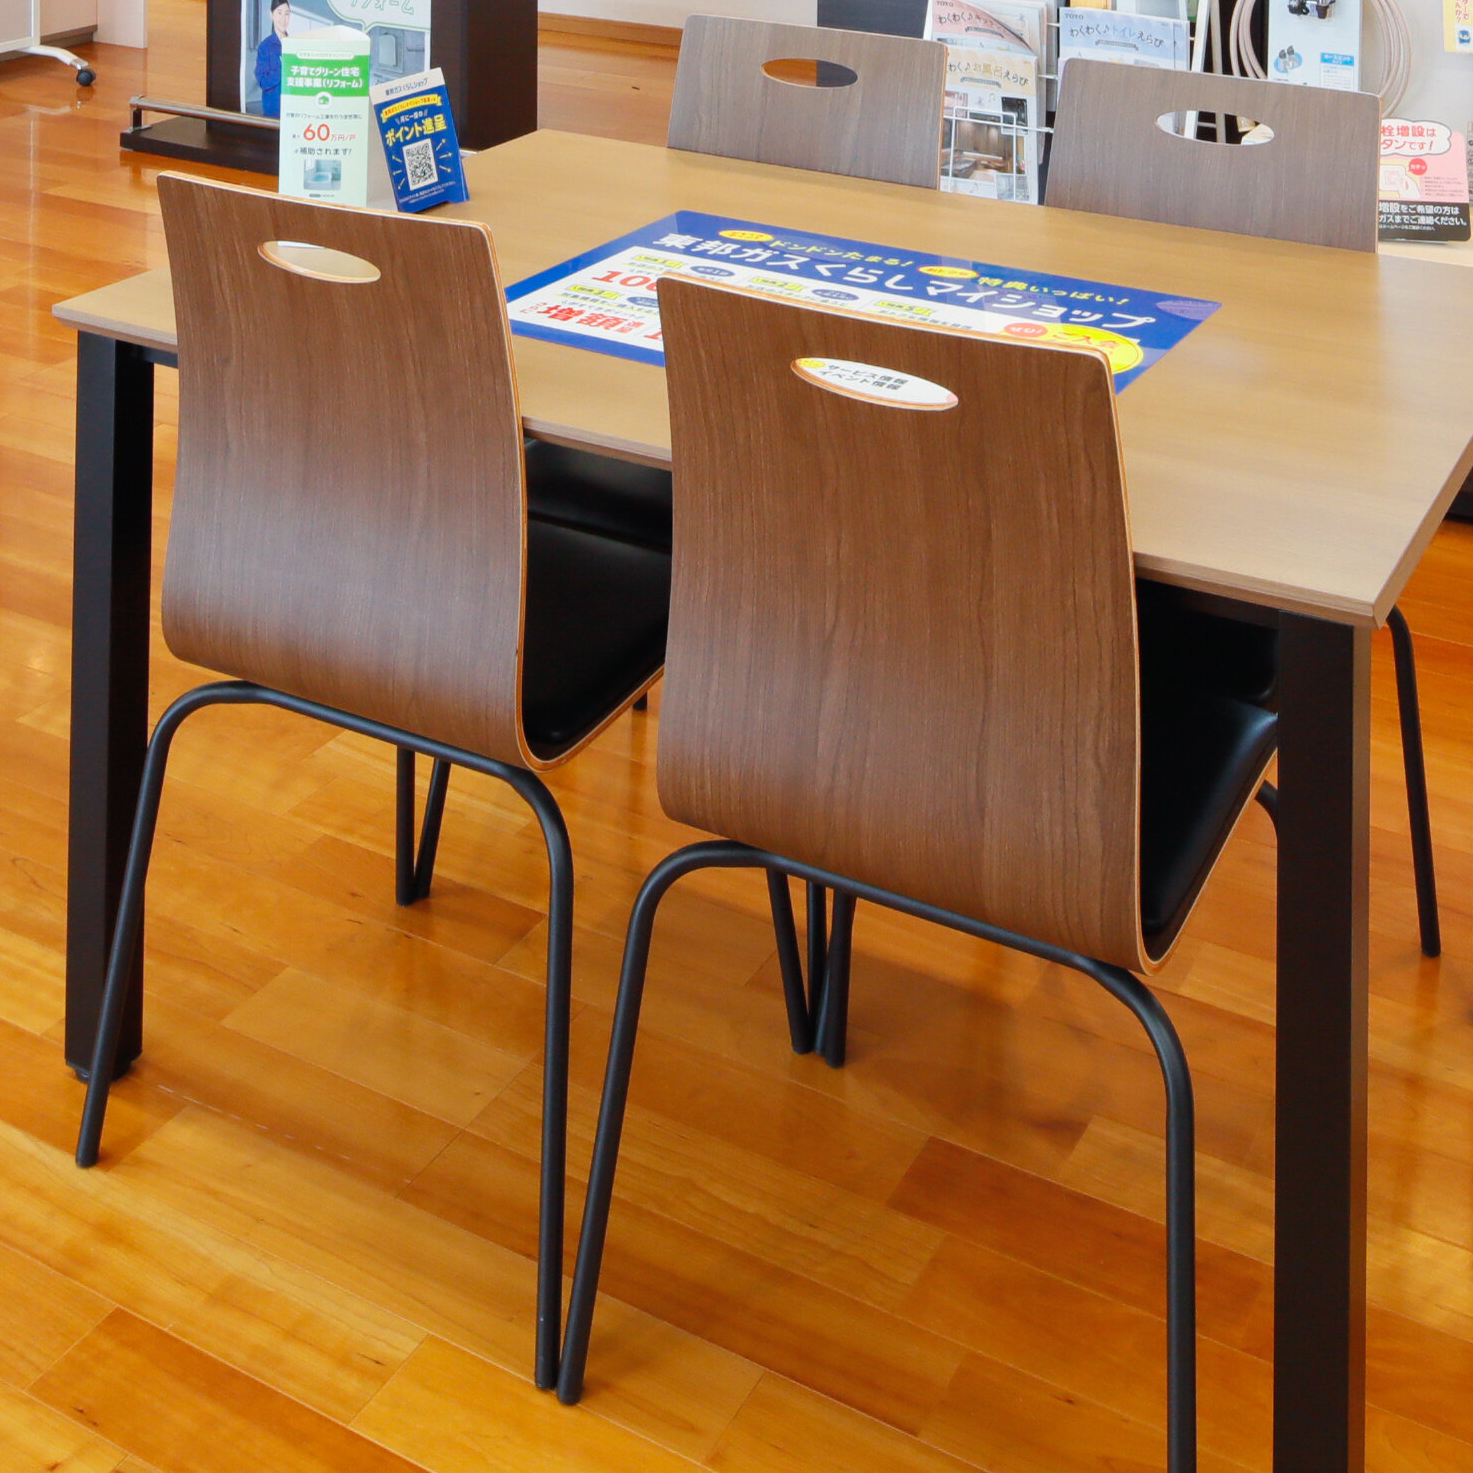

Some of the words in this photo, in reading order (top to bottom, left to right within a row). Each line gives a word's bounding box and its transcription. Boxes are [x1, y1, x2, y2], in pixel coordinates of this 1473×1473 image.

[1064, 12, 1085, 21] TOTO
[290, 65, 361, 77] 子育てグリーン住宅
[303, 123, 330, 142] 60
[385, 114, 448, 147] ポイント進呈
[653, 232, 1156, 329] 東邦ガスくらしマイショップ
[976, 276, 1132, 306] 特典いっぱい!
[537, 304, 620, 330] 増額
[819, 370, 902, 393] イベント情報
[827, 363, 909, 385] サービス情報
